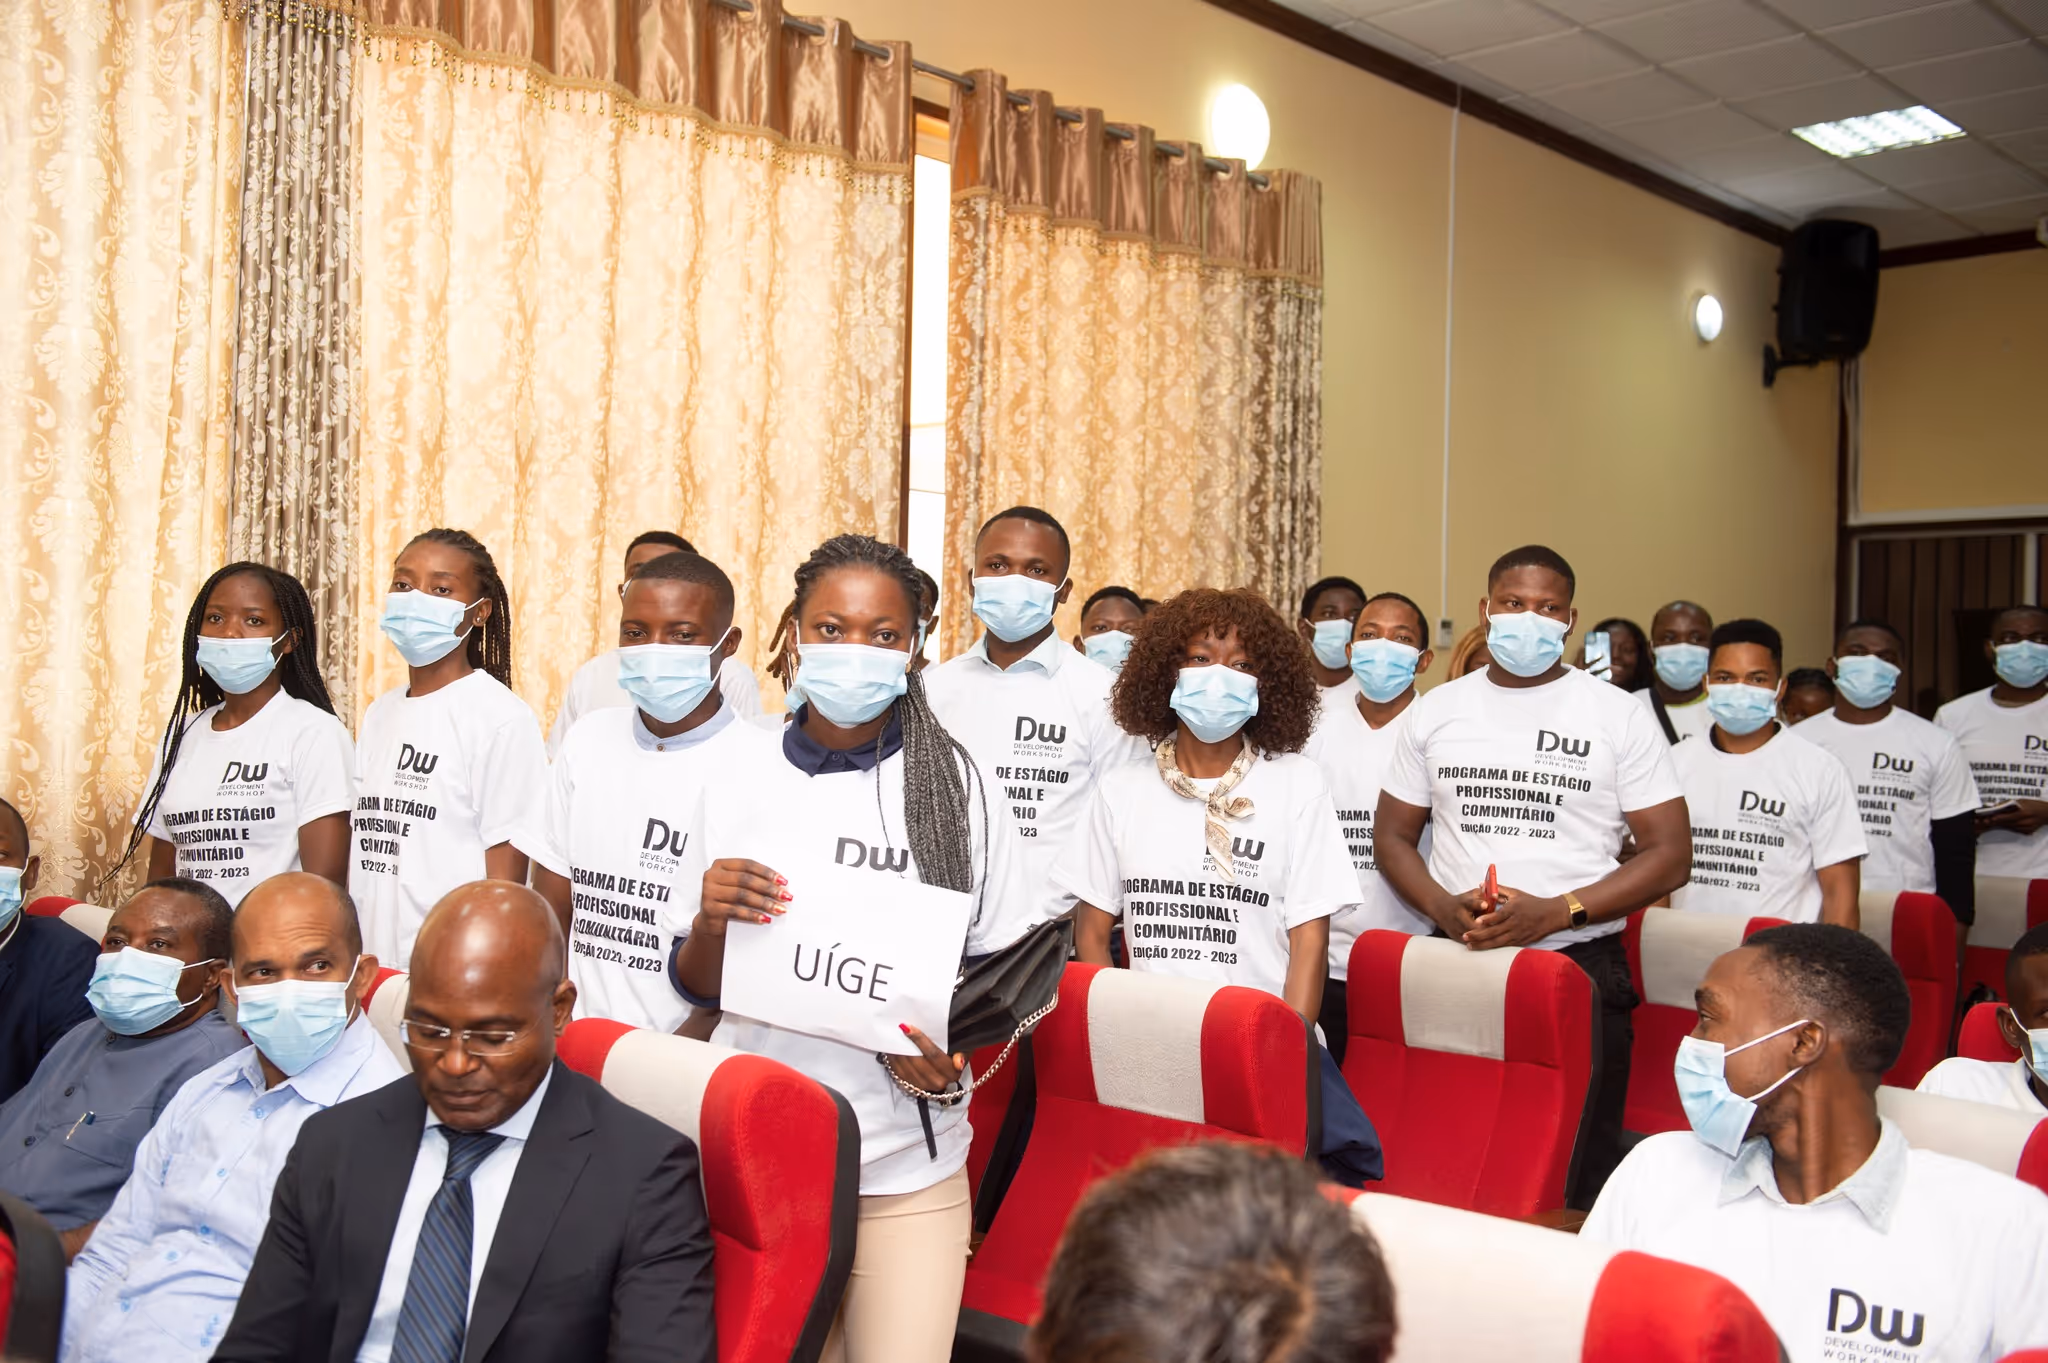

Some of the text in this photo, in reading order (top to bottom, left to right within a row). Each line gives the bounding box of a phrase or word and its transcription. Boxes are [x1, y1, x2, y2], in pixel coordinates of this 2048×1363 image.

[1013, 742, 1064, 753] DEVELOPMENT
[1013, 750, 1063, 759] WORKSHOP
[1534, 753, 1588, 766] DEVELOPMENT
[1534, 759, 1588, 772] WORKSHOP
[1014, 766, 1070, 784] ESTÁGIO
[1438, 766, 1592, 793] PROGRAMA DE ESTÁGIO
[1036, 788, 1045, 801] E
[1456, 785, 1564, 806] PROFISSIONAL E
[201, 808, 214, 822] DE
[216, 806, 276, 821] ESTÁGIO
[1461, 803, 1555, 823] COMUNITÁRIO
[241, 828, 250, 841] E
[401, 823, 411, 838] E
[1460, 823, 1491, 835] EDIÇÃO
[1494, 825, 1521, 837] 2022
[1528, 828, 1556, 840] 2023
[1722, 829, 1737, 841] DE
[1739, 831, 1785, 848] ESTÁGIO
[1758, 851, 1765, 862] E
[195, 868, 213, 879] 2022
[220, 867, 250, 879] 2023
[570, 866, 616, 892] GRAMA
[618, 876, 637, 896] DE
[1188, 882, 1206, 898] DE
[1209, 883, 1270, 908] ESTÁGIO
[1736, 881, 1760, 892] 2023
[1131, 901, 1232, 924] PROFISSIONAL
[1134, 923, 1237, 946] COMUNITÁRIO
[596, 946, 623, 964] 2022
[628, 955, 663, 973] 2023
[1133, 945, 1169, 961] EDIÇÃO
[1171, 947, 1201, 961] 2022
[1211, 951, 1238, 965] 2023
[793, 941, 894, 1002] UÍGE
